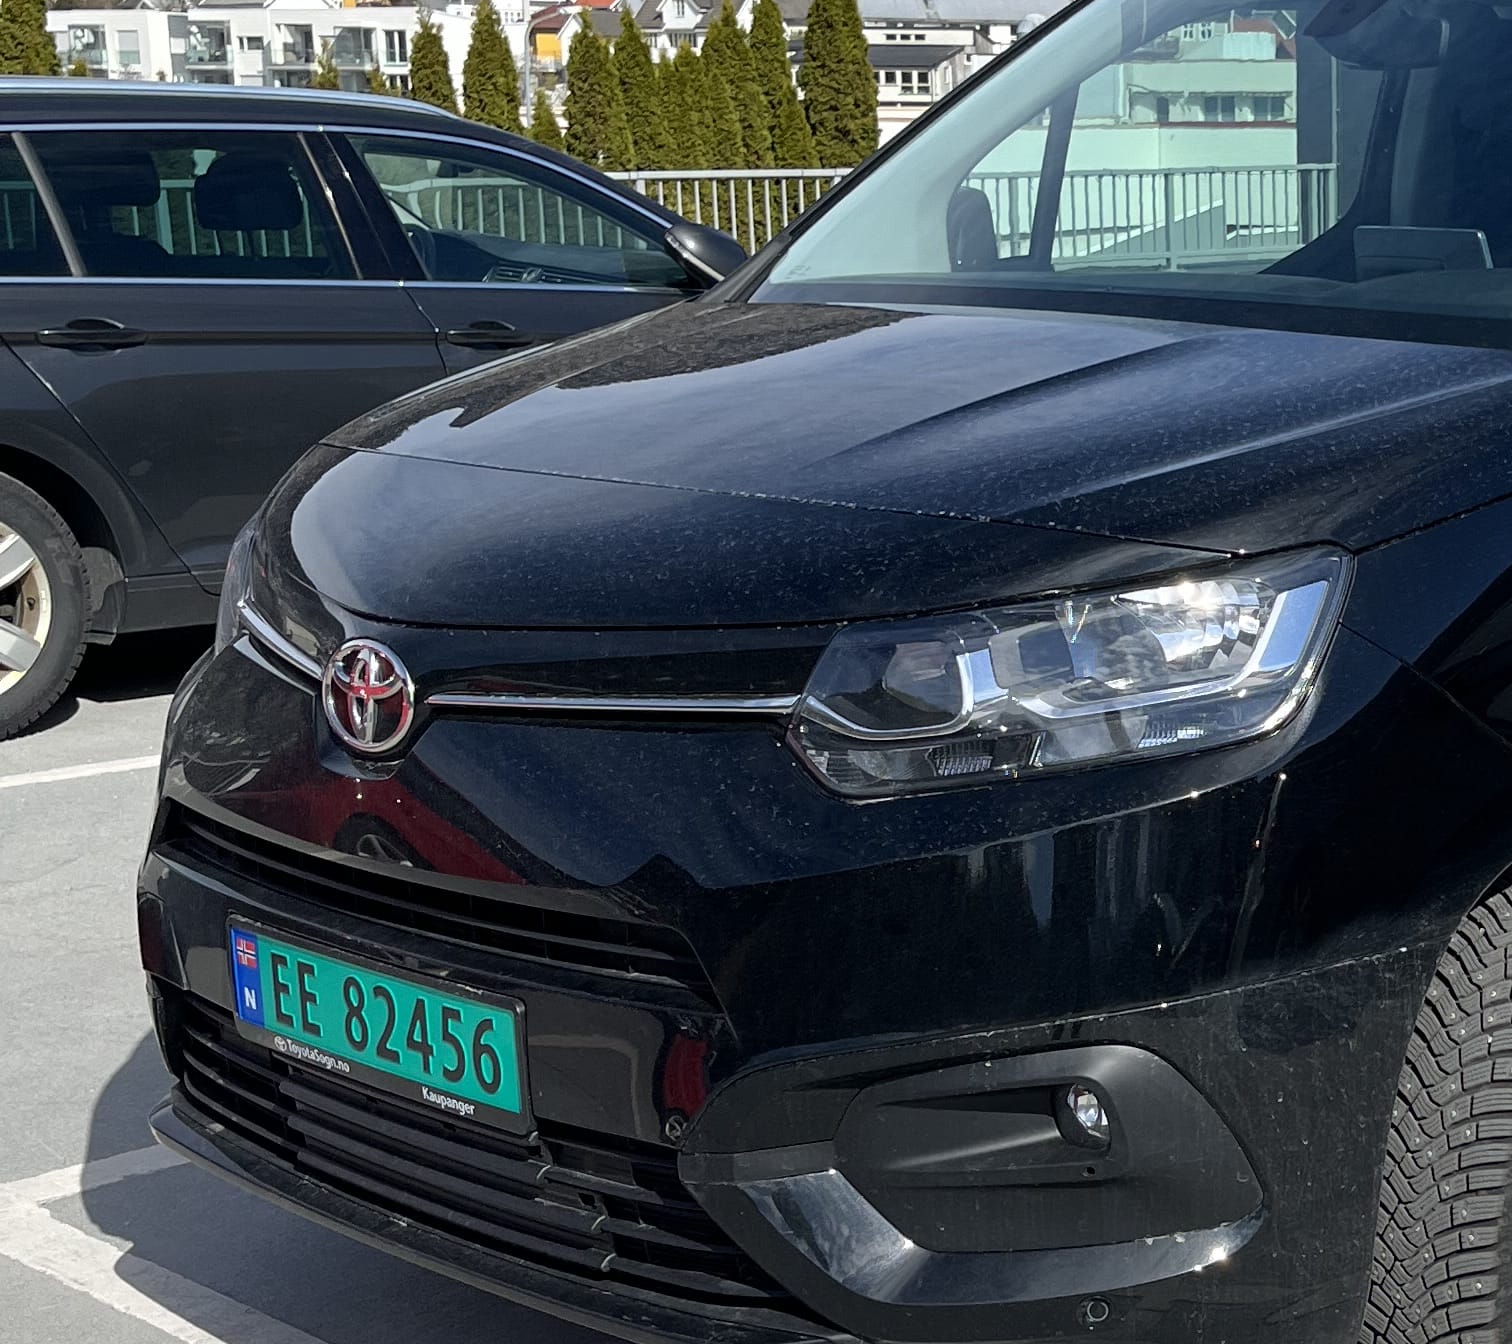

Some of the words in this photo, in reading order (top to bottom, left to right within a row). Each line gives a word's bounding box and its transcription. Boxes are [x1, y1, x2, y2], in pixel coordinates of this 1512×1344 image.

[243, 986, 257, 1010] N
[270, 952, 322, 1037] EE
[343, 976, 502, 1095] 82456
[286, 1038, 350, 1073] ToyotaSogn.no
[421, 1086, 475, 1116] Kaupanger
